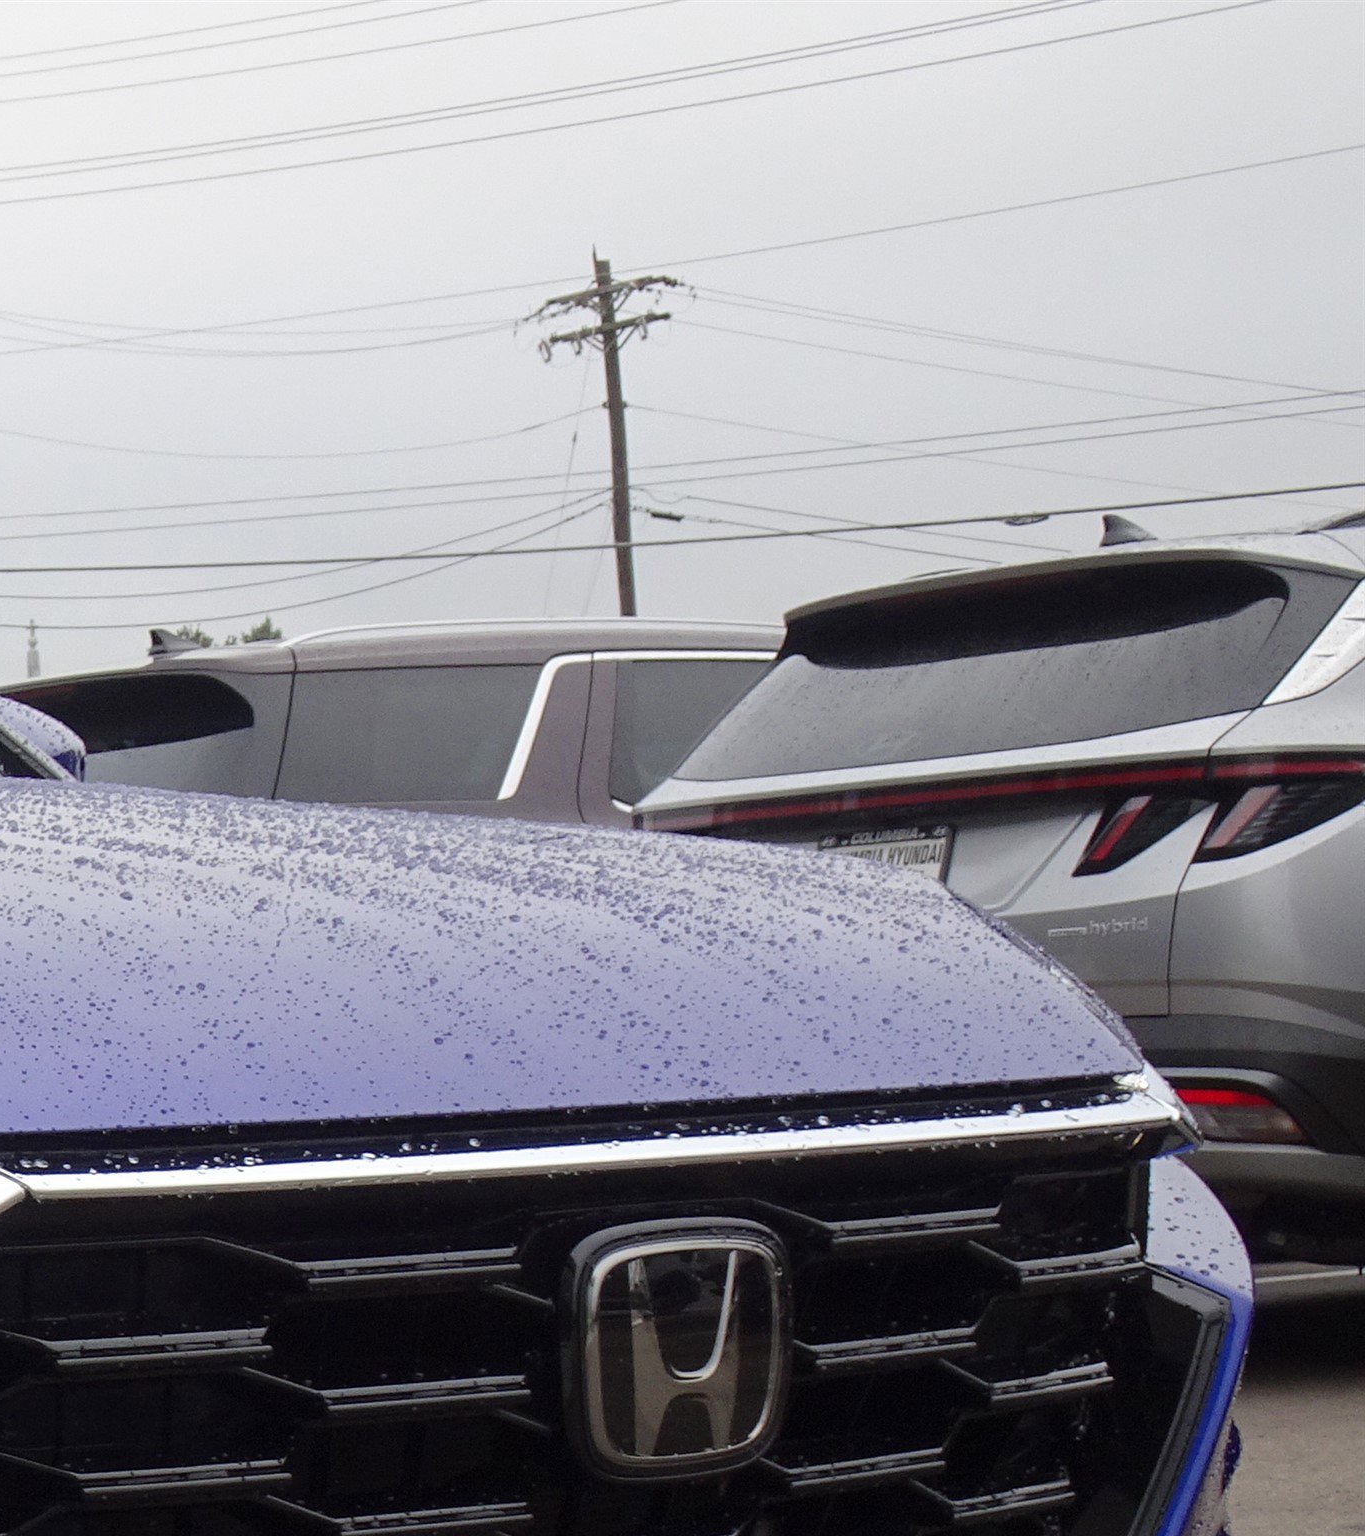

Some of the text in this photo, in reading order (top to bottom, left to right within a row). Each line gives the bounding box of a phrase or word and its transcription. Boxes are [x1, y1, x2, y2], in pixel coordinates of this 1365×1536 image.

[850, 827, 918, 845] COLUMBIA
[887, 843, 945, 866] HYUNDAI
[1089, 917, 1148, 937] hybrid
